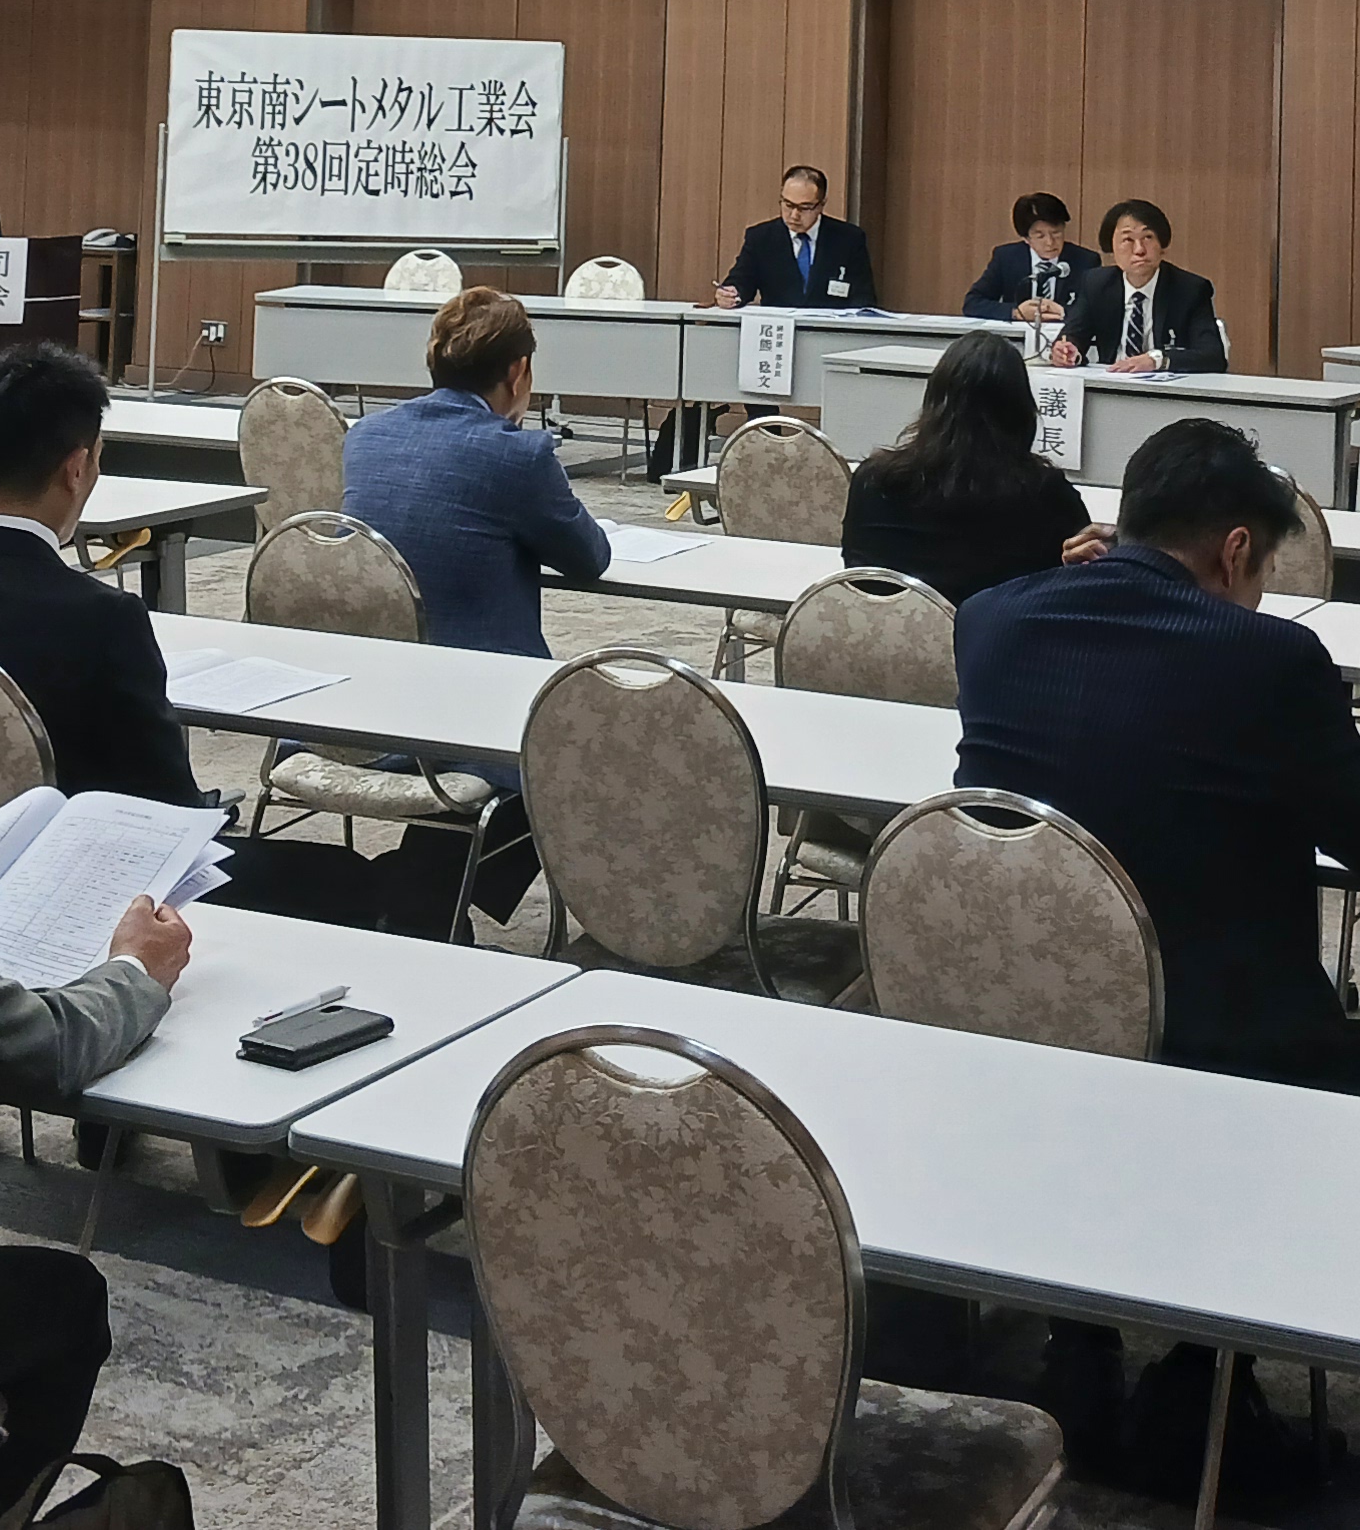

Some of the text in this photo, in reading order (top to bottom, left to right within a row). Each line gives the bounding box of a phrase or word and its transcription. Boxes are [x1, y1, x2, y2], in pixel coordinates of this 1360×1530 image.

[192, 70, 539, 139] 東京南シートメタル工業会
[249, 135, 479, 201] 第38回定時総会
[1036, 387, 1068, 457] 議長
